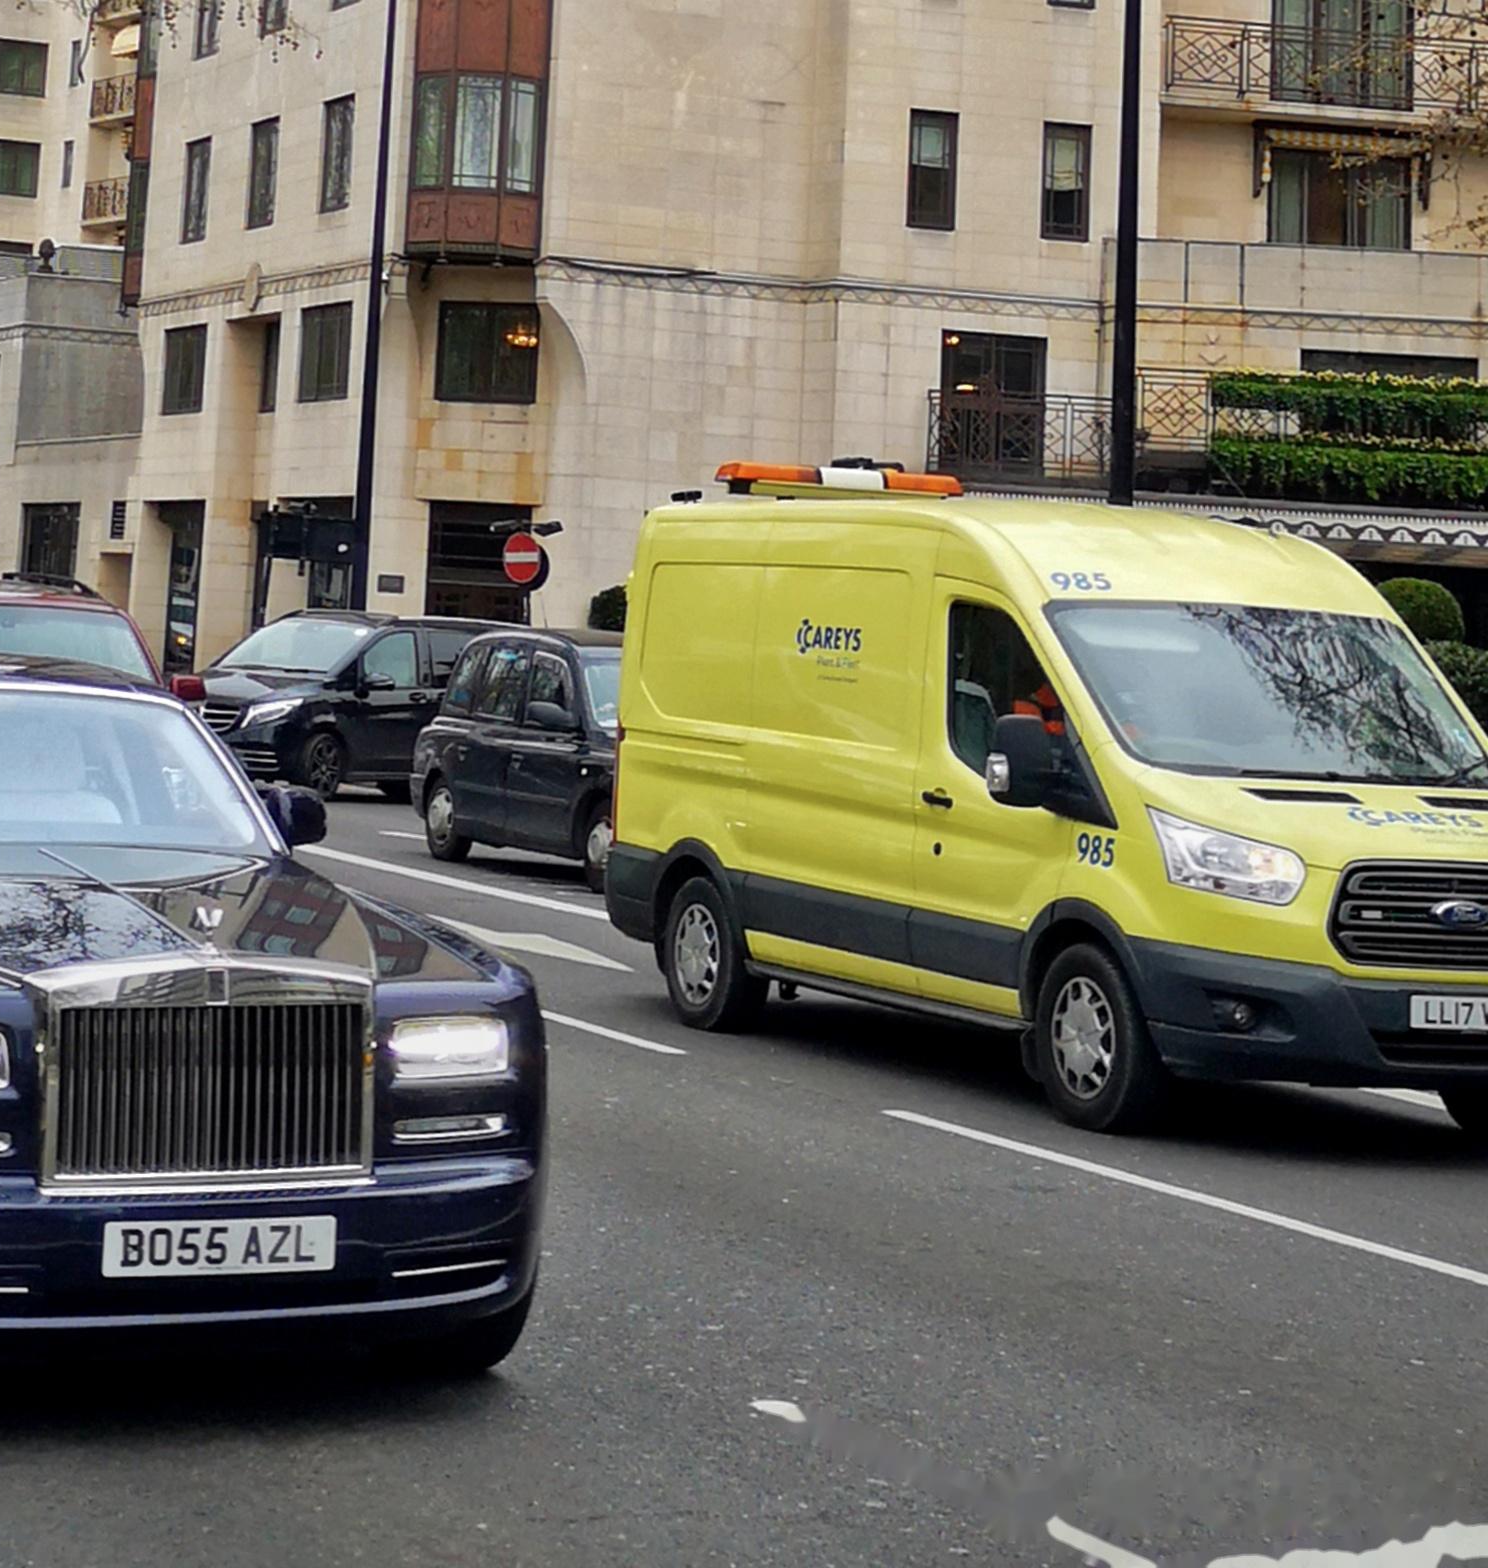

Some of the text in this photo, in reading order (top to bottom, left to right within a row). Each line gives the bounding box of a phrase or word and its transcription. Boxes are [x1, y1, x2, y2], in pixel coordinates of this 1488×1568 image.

[1050, 572, 1112, 591] 985
[802, 624, 862, 652] CAREYS
[1360, 809, 1483, 828] CAREYS
[1077, 832, 1116, 868] 985
[1424, 1001, 1474, 1025] LL17
[242, 1225, 316, 1265] AZL
